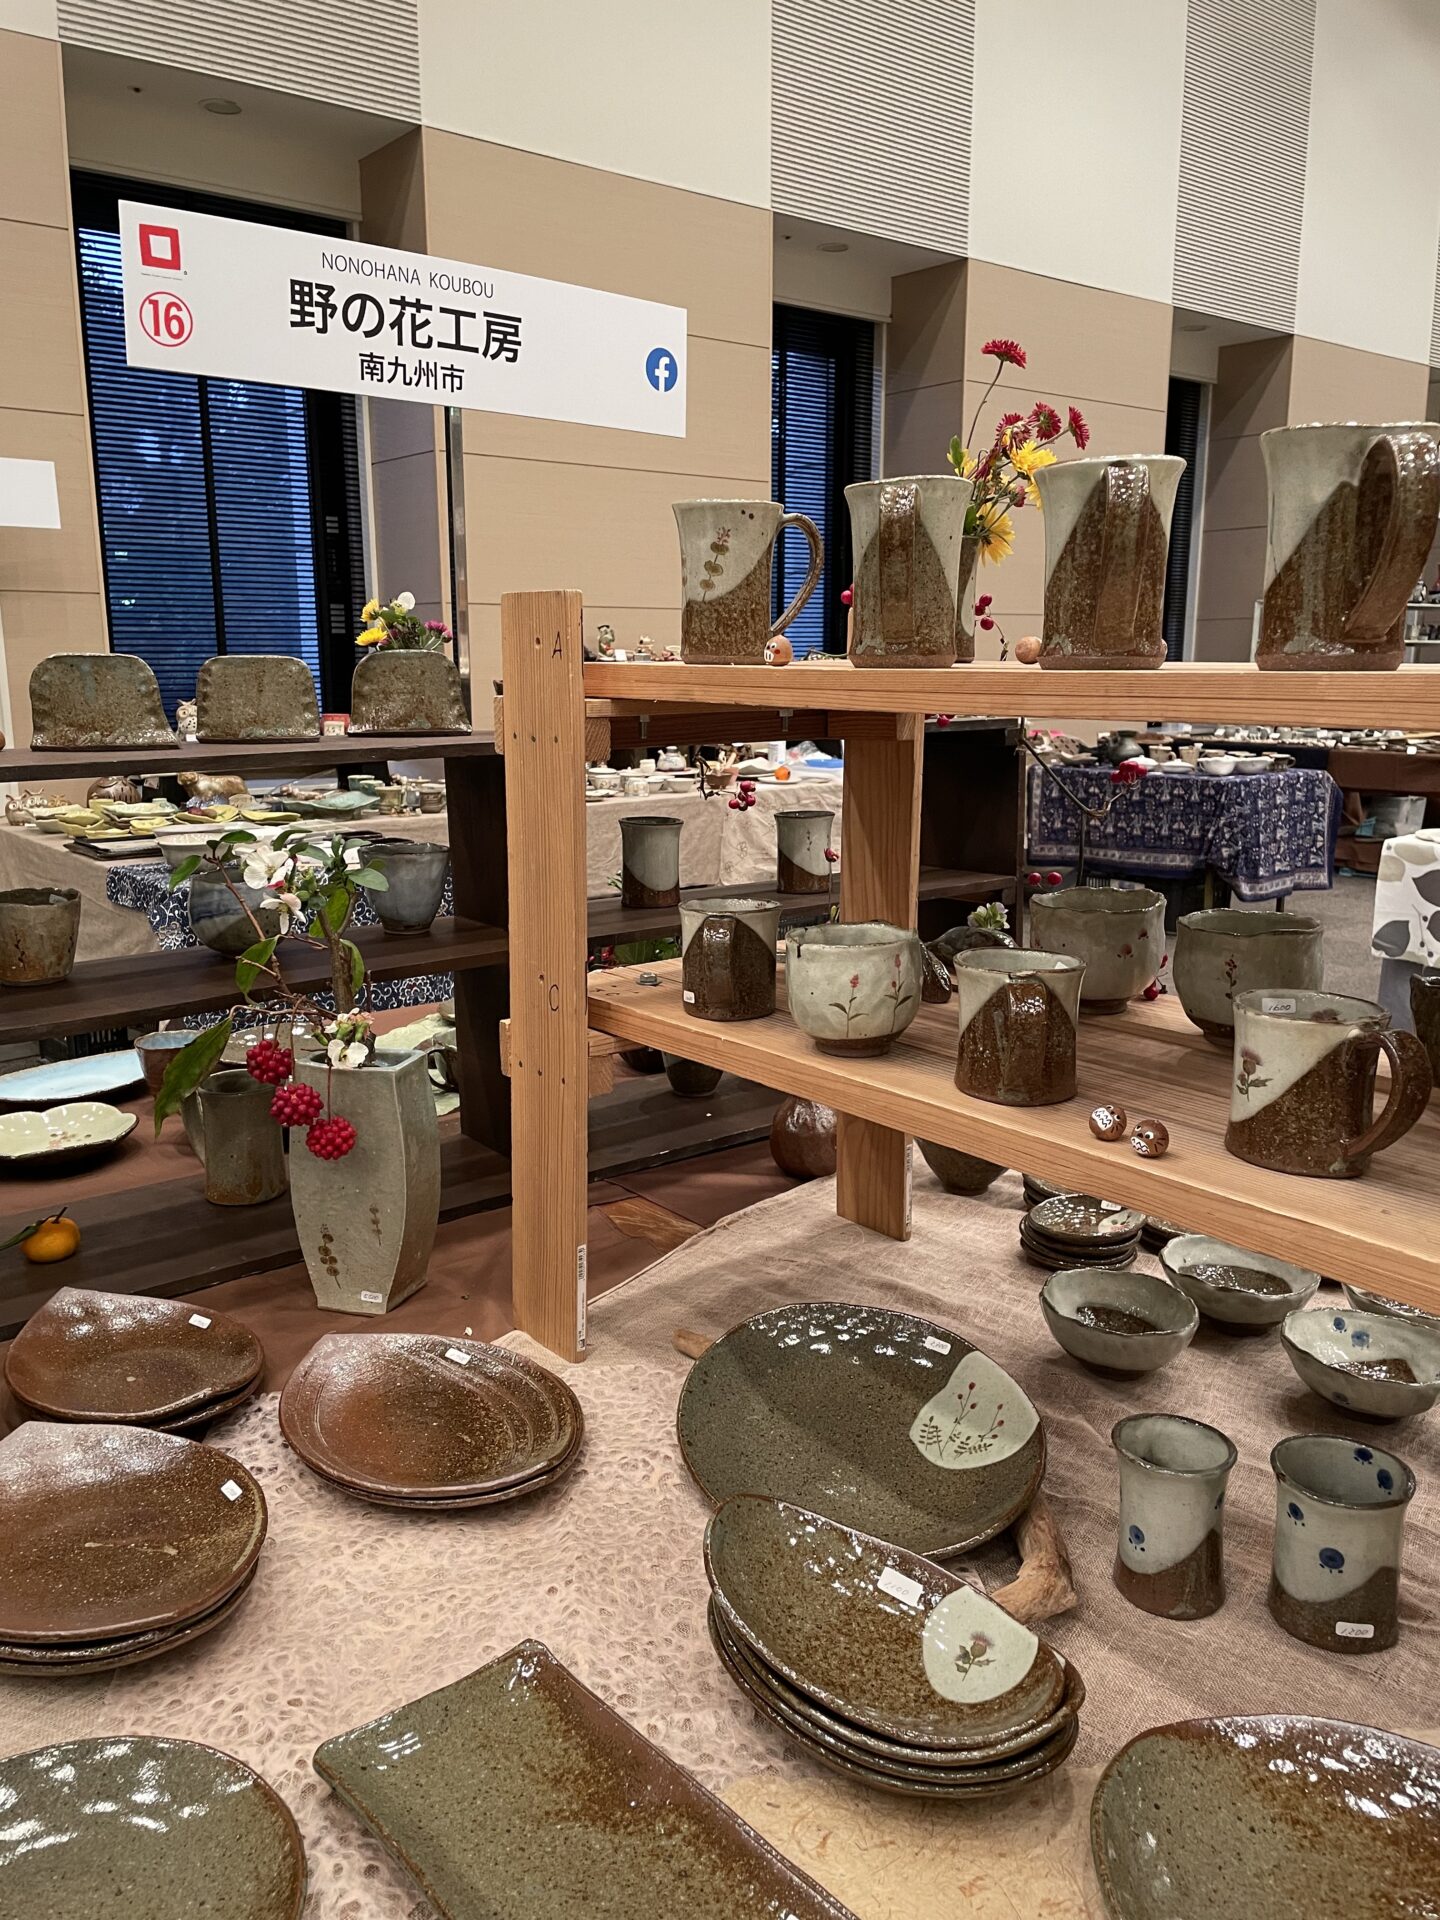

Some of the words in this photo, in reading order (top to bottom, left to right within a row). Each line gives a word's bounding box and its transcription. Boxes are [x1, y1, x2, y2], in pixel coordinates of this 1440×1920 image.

[321, 252, 421, 286] NONOHANA
[429, 271, 494, 299] KOUBOU
[146, 297, 186, 341] 16
[289, 278, 523, 364] 野の花工房
[358, 351, 465, 393] 南九州市
[551, 630, 563, 660] A
[548, 983, 560, 1012] C
